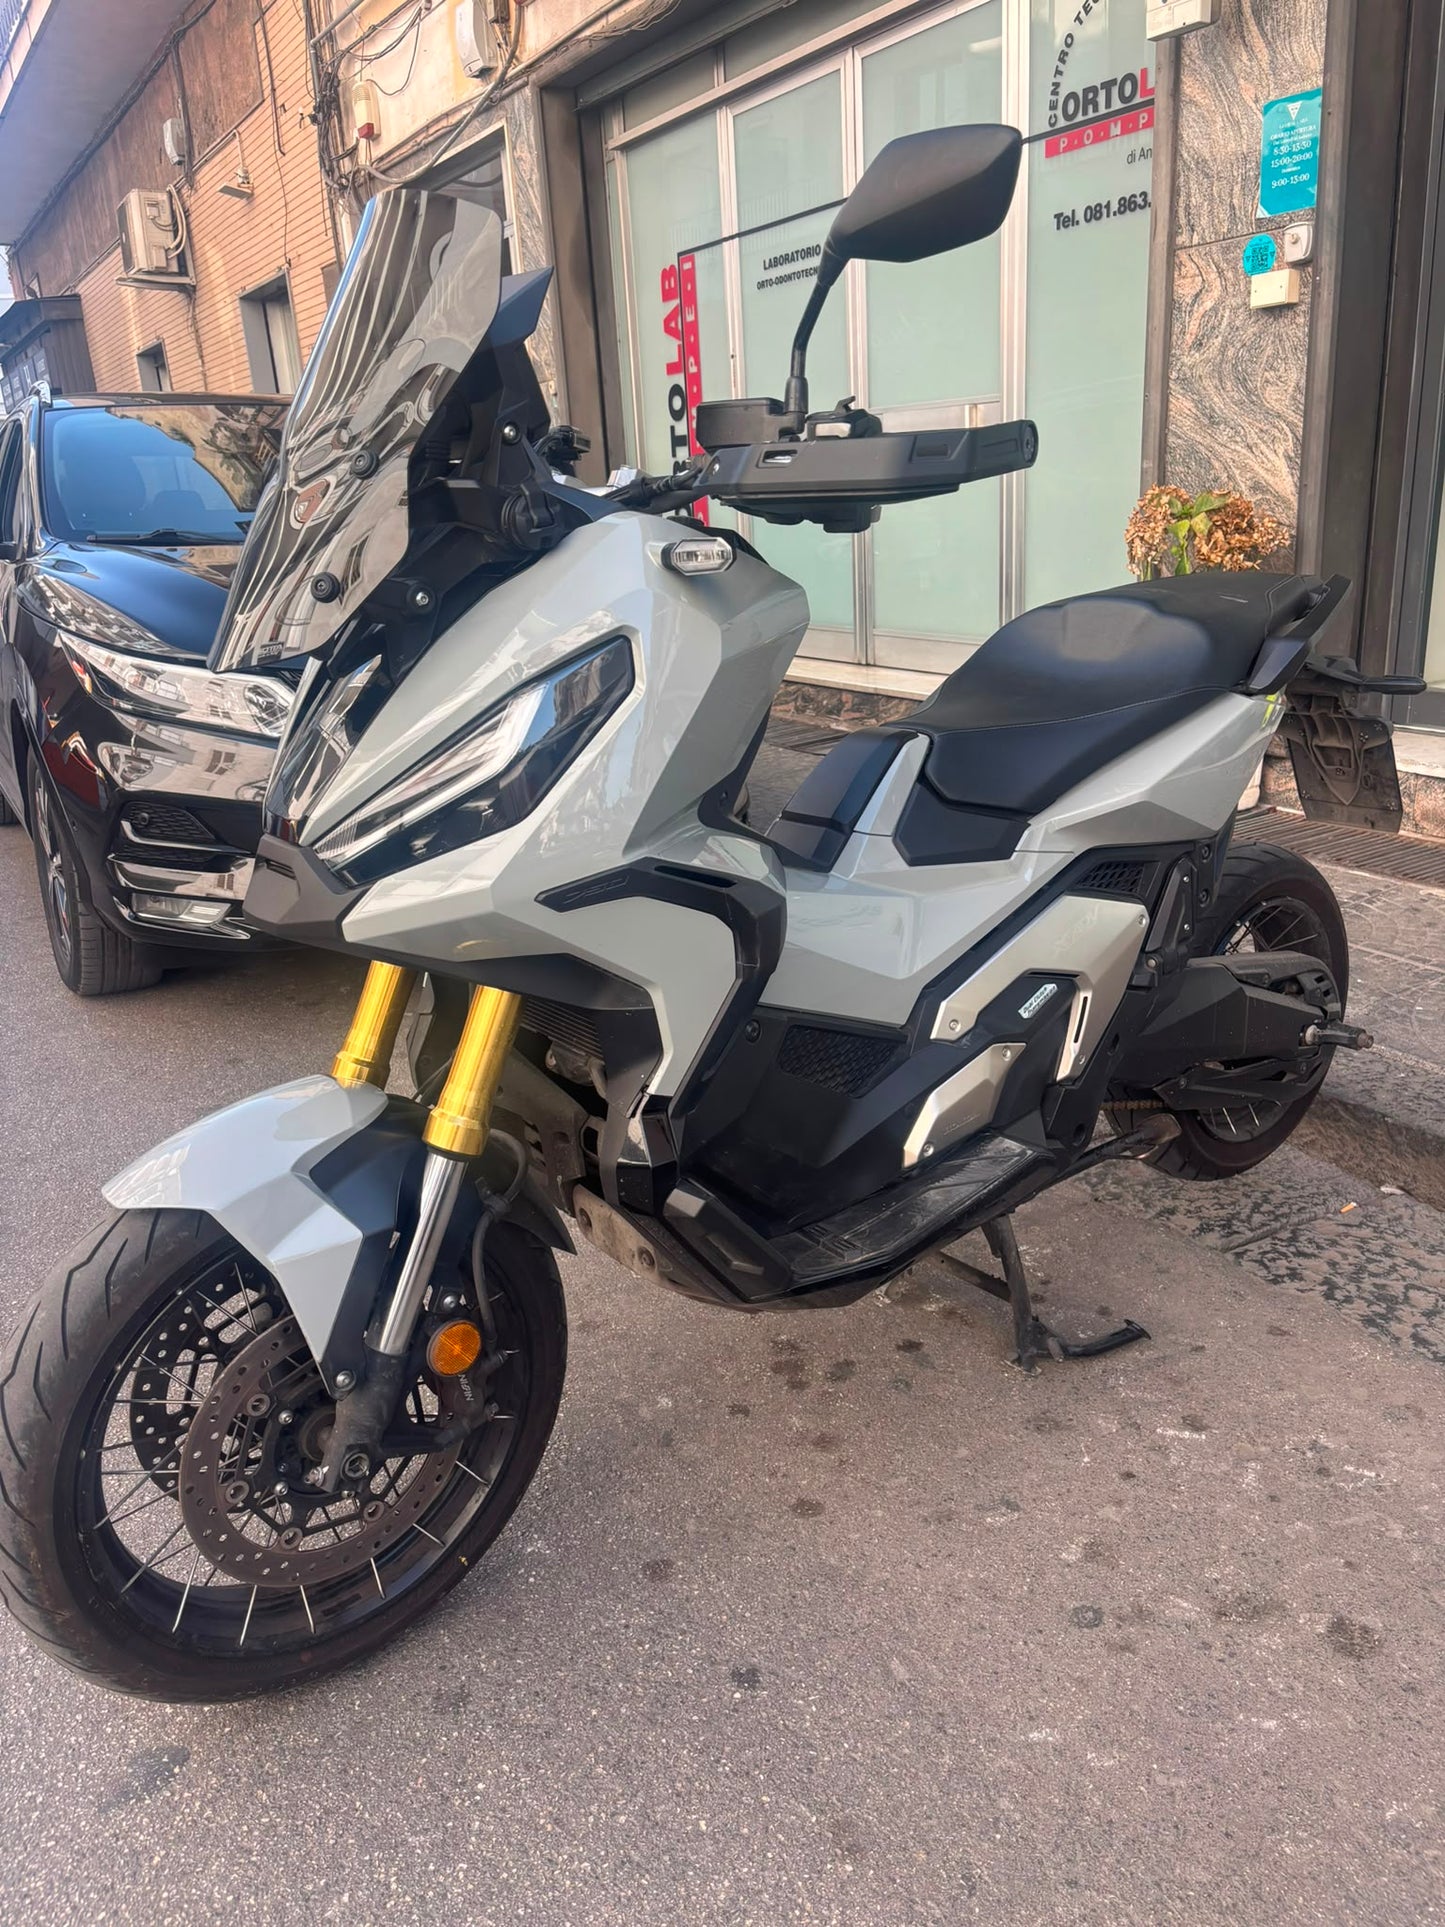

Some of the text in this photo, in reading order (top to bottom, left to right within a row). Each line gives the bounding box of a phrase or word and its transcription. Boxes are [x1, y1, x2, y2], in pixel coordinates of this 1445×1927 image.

[1048, 32, 1075, 128] CENTRO
[1127, 149, 1137, 165] di
[1053, 208, 1080, 231] Tel.
[763, 243, 821, 271] LABORATORIO
